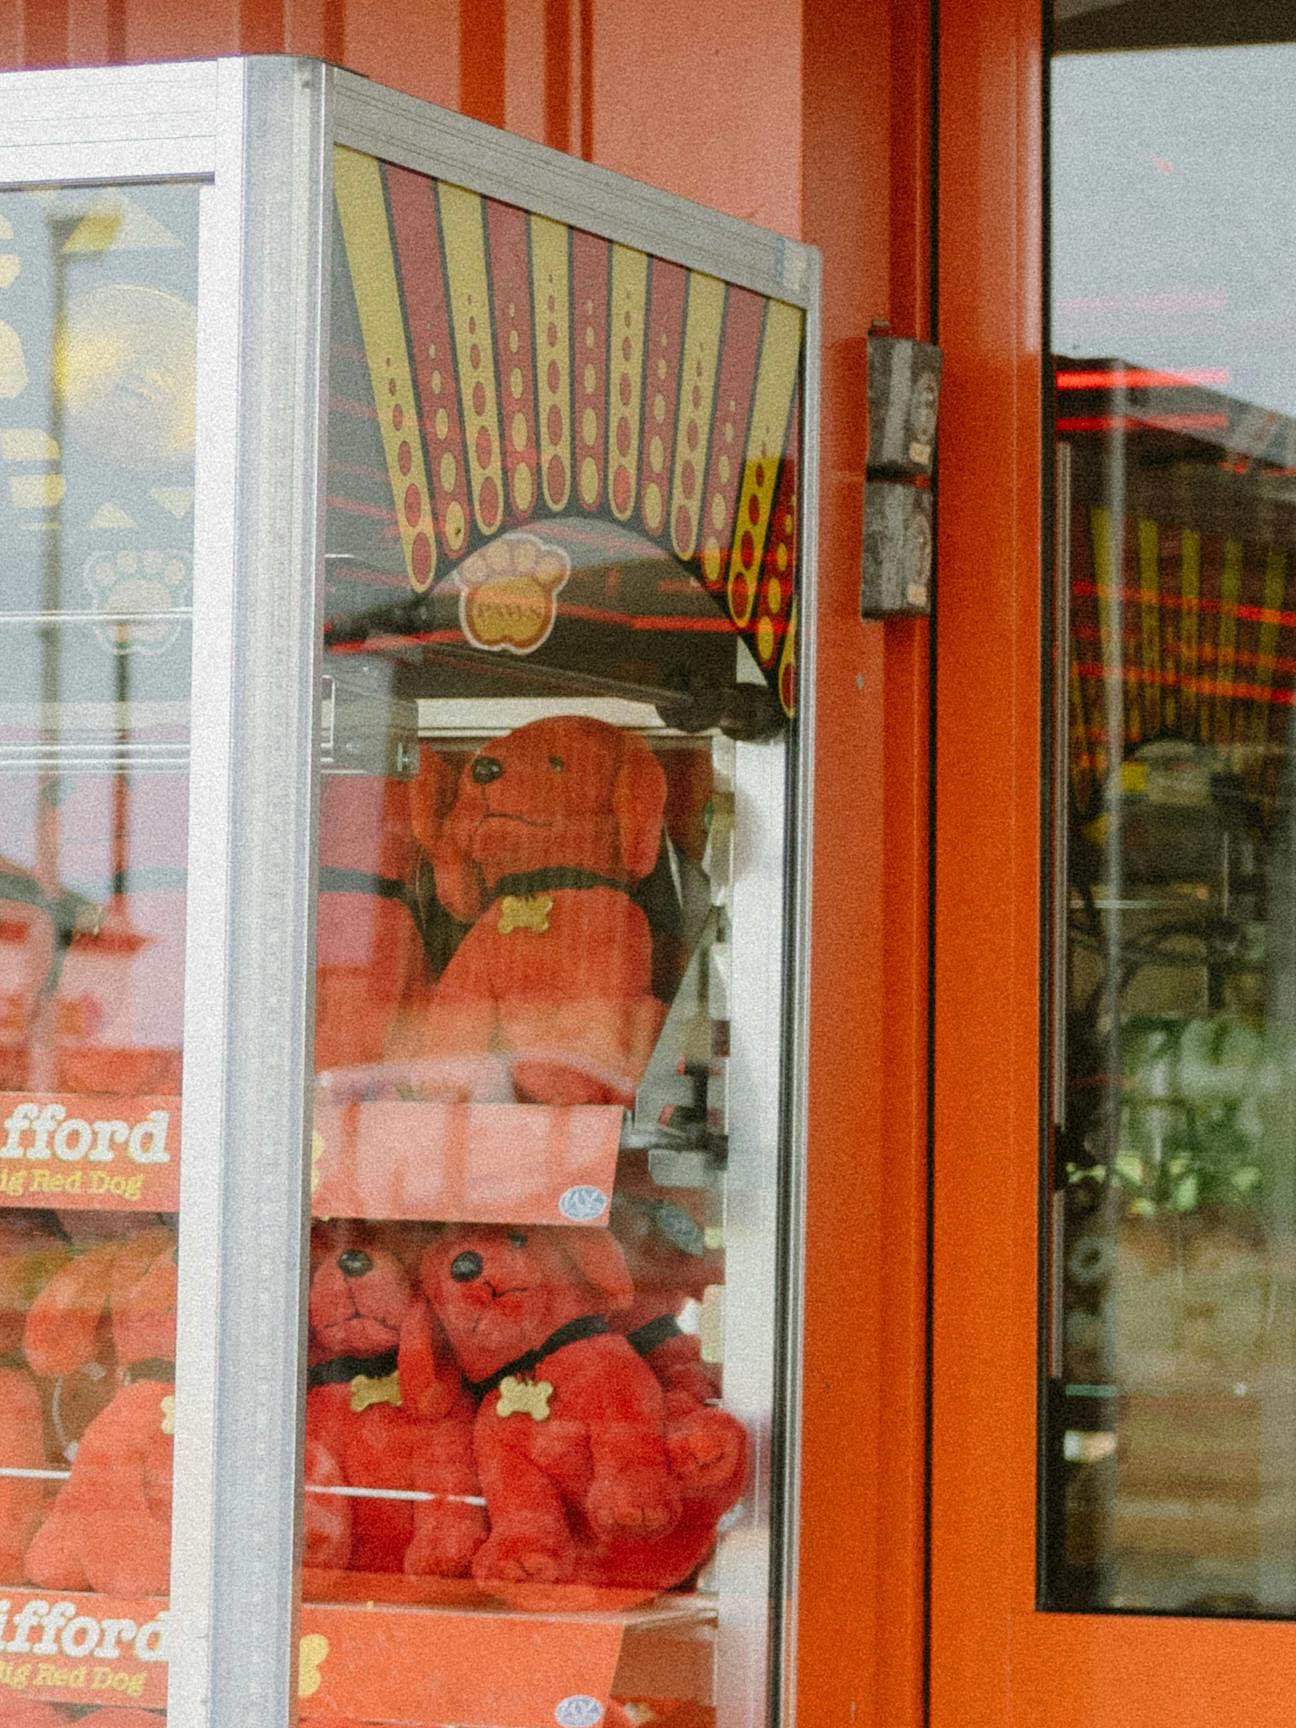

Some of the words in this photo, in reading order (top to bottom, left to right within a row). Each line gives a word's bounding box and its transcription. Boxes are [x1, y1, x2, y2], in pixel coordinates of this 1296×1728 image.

[29, 1168, 82, 1193] Red
[89, 1171, 144, 1201] Dog
[33, 1663, 85, 1688] Red
[90, 1665, 146, 1697] Dog
